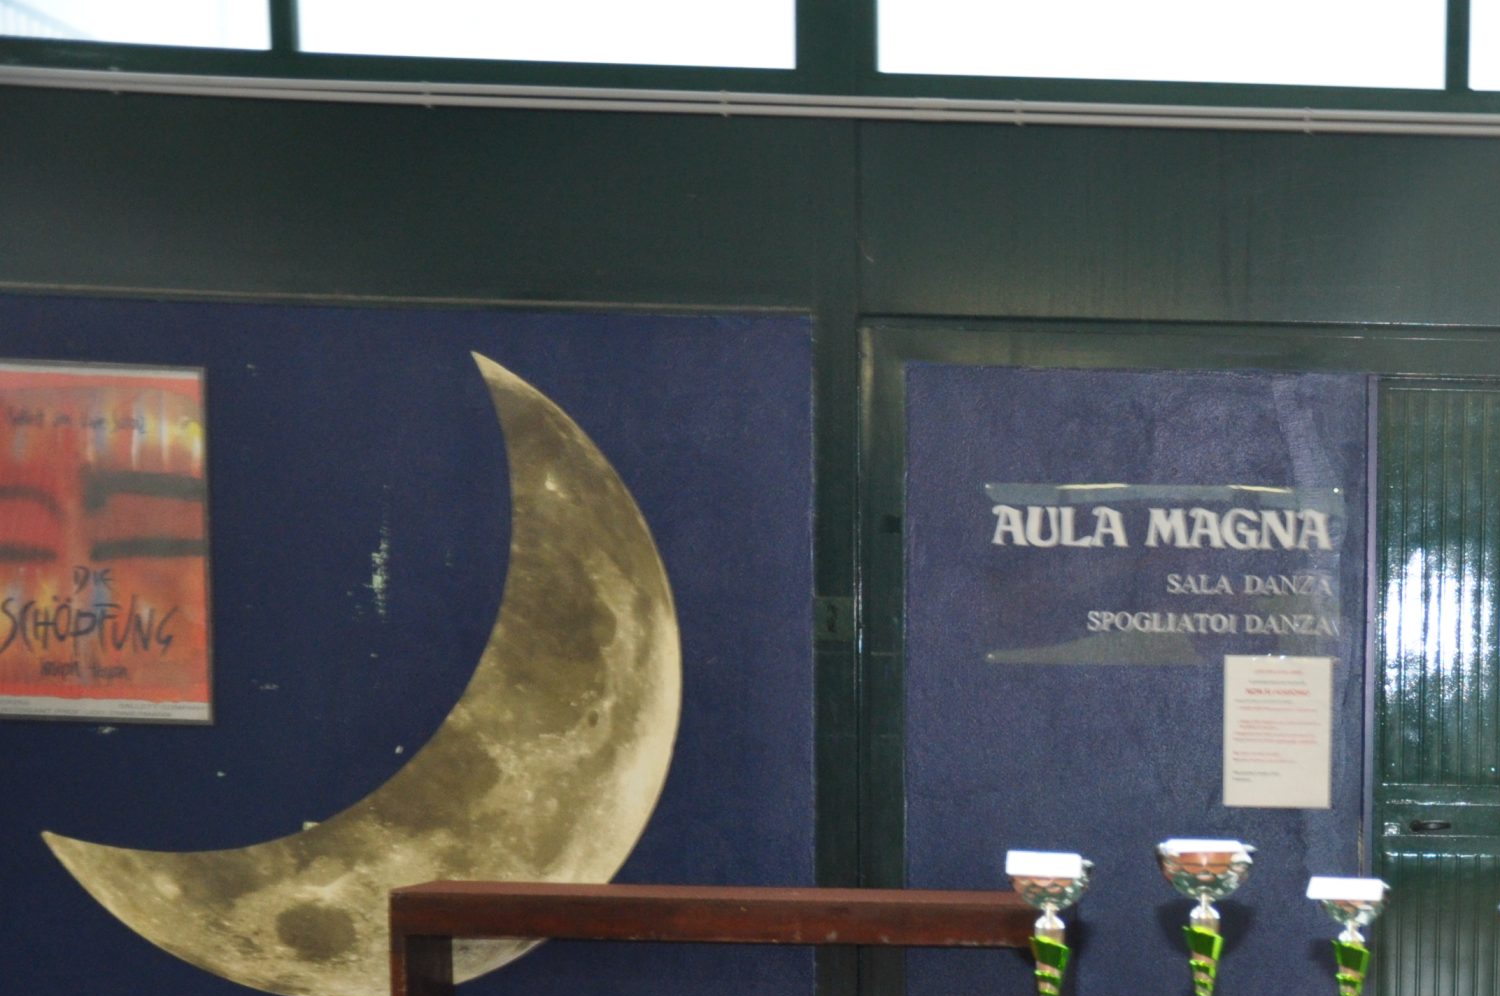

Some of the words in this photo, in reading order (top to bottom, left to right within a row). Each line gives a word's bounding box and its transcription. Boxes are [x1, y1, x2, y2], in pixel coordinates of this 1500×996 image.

[992, 505, 1129, 549] AULA
[1145, 507, 1333, 551] MAGNA
[1166, 573, 1234, 595] SALA
[1245, 574, 1333, 597] DANZA
[1087, 611, 1237, 634] SPOGLIATOI
[1245, 614, 1334, 637] DANZA
